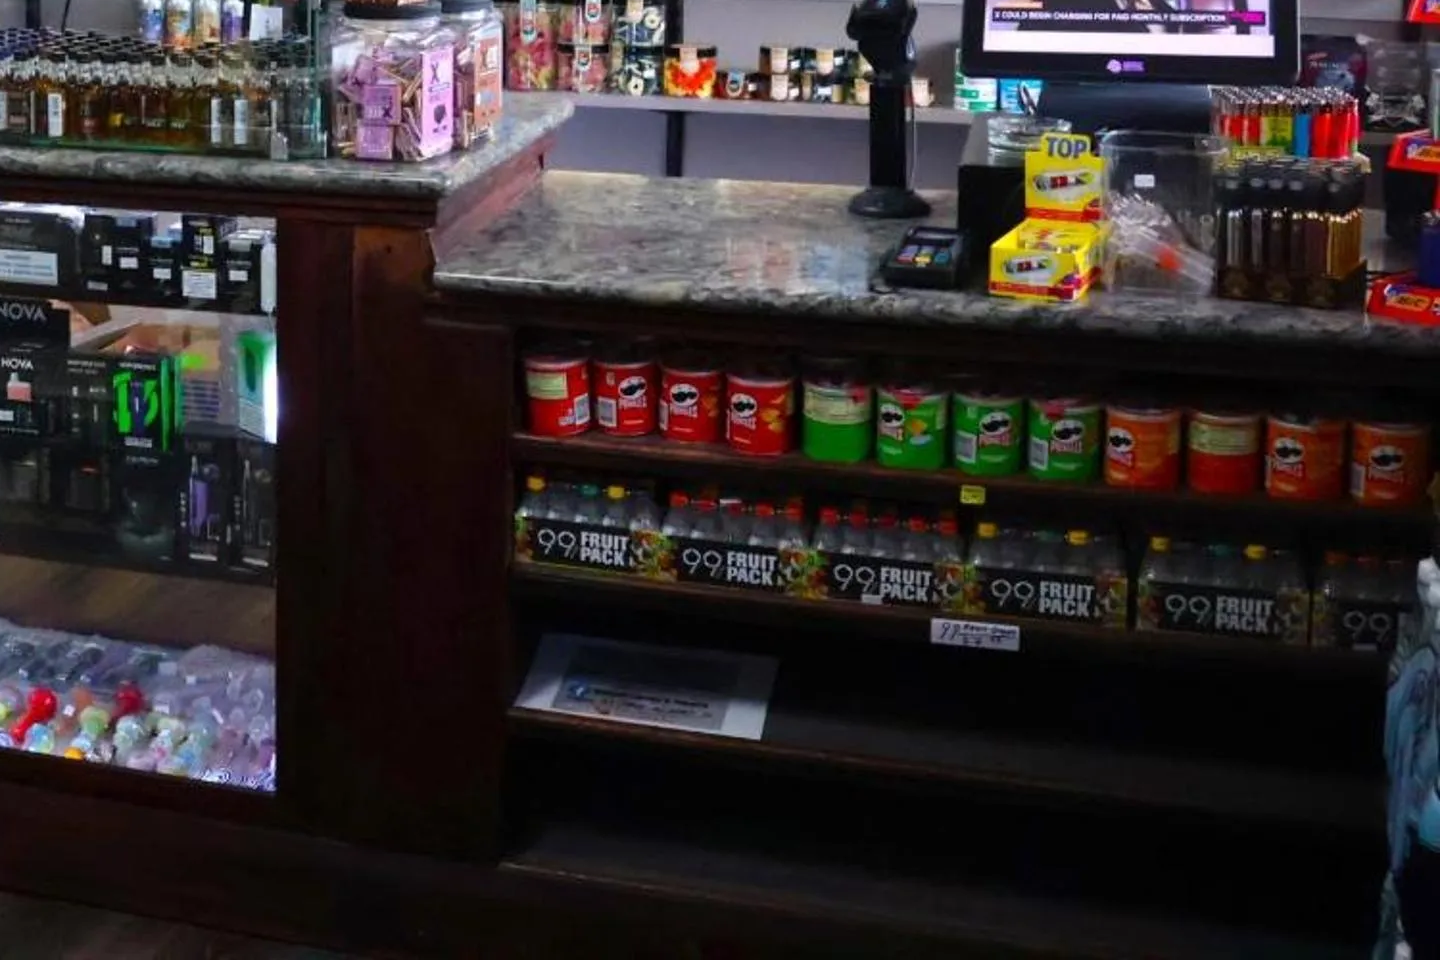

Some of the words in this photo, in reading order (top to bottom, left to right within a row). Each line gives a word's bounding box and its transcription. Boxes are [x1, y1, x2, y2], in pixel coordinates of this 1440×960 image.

[1094, 13, 1110, 21] FOR
[1047, 138, 1088, 158] TOP
[1, 357, 34, 371] NOVA
[537, 529, 576, 558] 99
[580, 531, 629, 551] FRUIT
[580, 547, 625, 566] PACK
[683, 548, 722, 577] 99
[727, 550, 777, 570] FRUIT
[726, 567, 773, 586] PACK
[834, 564, 876, 592] 99
[880, 566, 932, 587] FRUIT
[880, 583, 928, 602] PACK
[991, 579, 1034, 608] 99
[1040, 581, 1095, 601] FRUIT
[1039, 598, 1090, 617] PACK
[1165, 594, 1210, 623] 99
[1216, 595, 1274, 617] FRUIT
[1215, 611, 1270, 633] PACK
